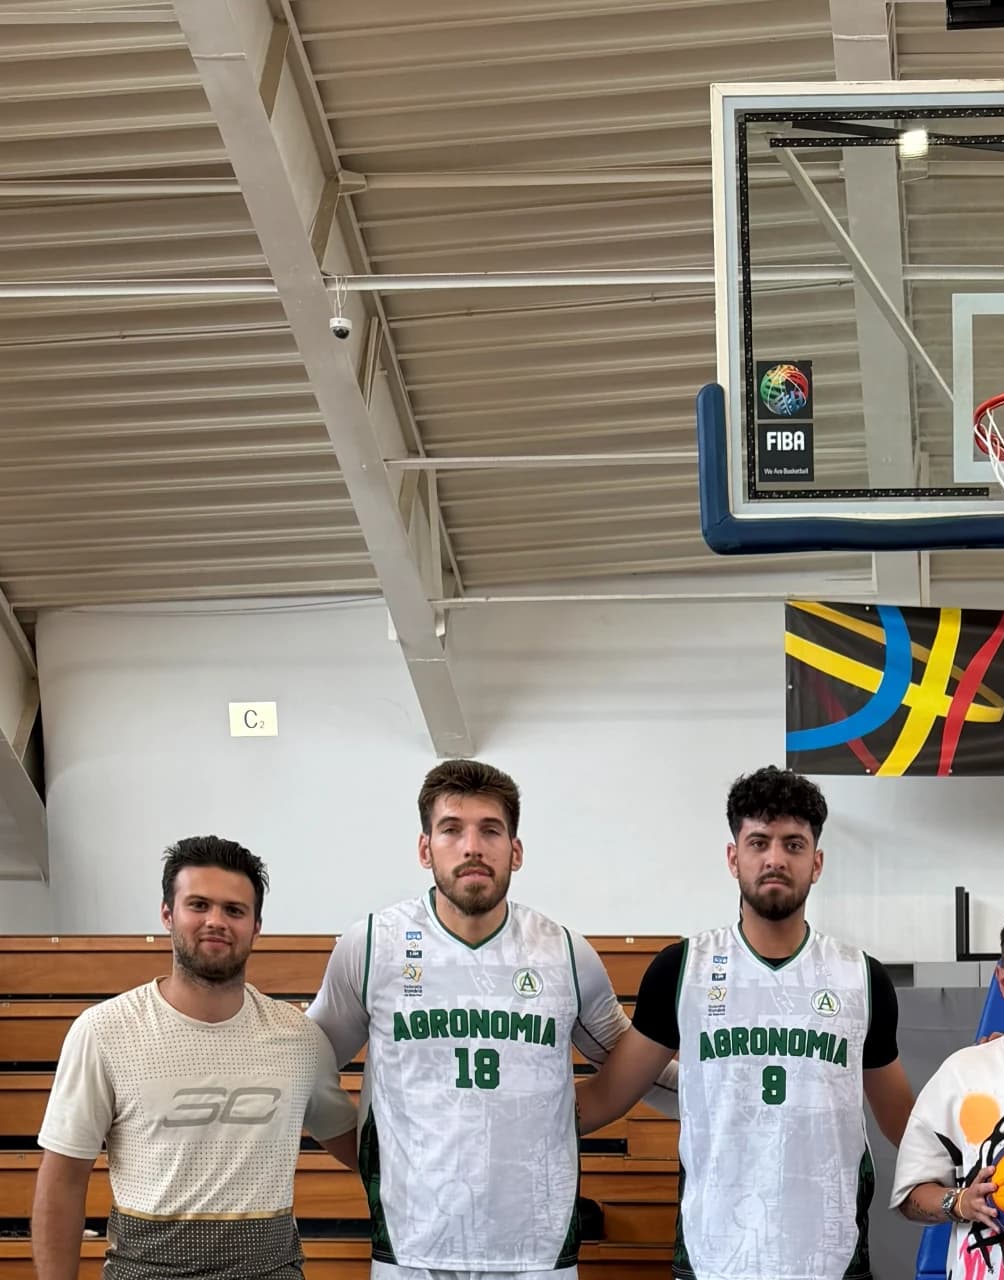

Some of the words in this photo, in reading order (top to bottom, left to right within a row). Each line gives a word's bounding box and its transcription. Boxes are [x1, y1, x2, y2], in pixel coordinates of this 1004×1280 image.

[766, 431, 805, 451] FIBA
[393, 1009, 556, 1048] AGRONOMIA
[700, 1027, 848, 1068] AGRONOMIA
[455, 1047, 501, 1090] 18
[762, 1065, 787, 1105] 9
